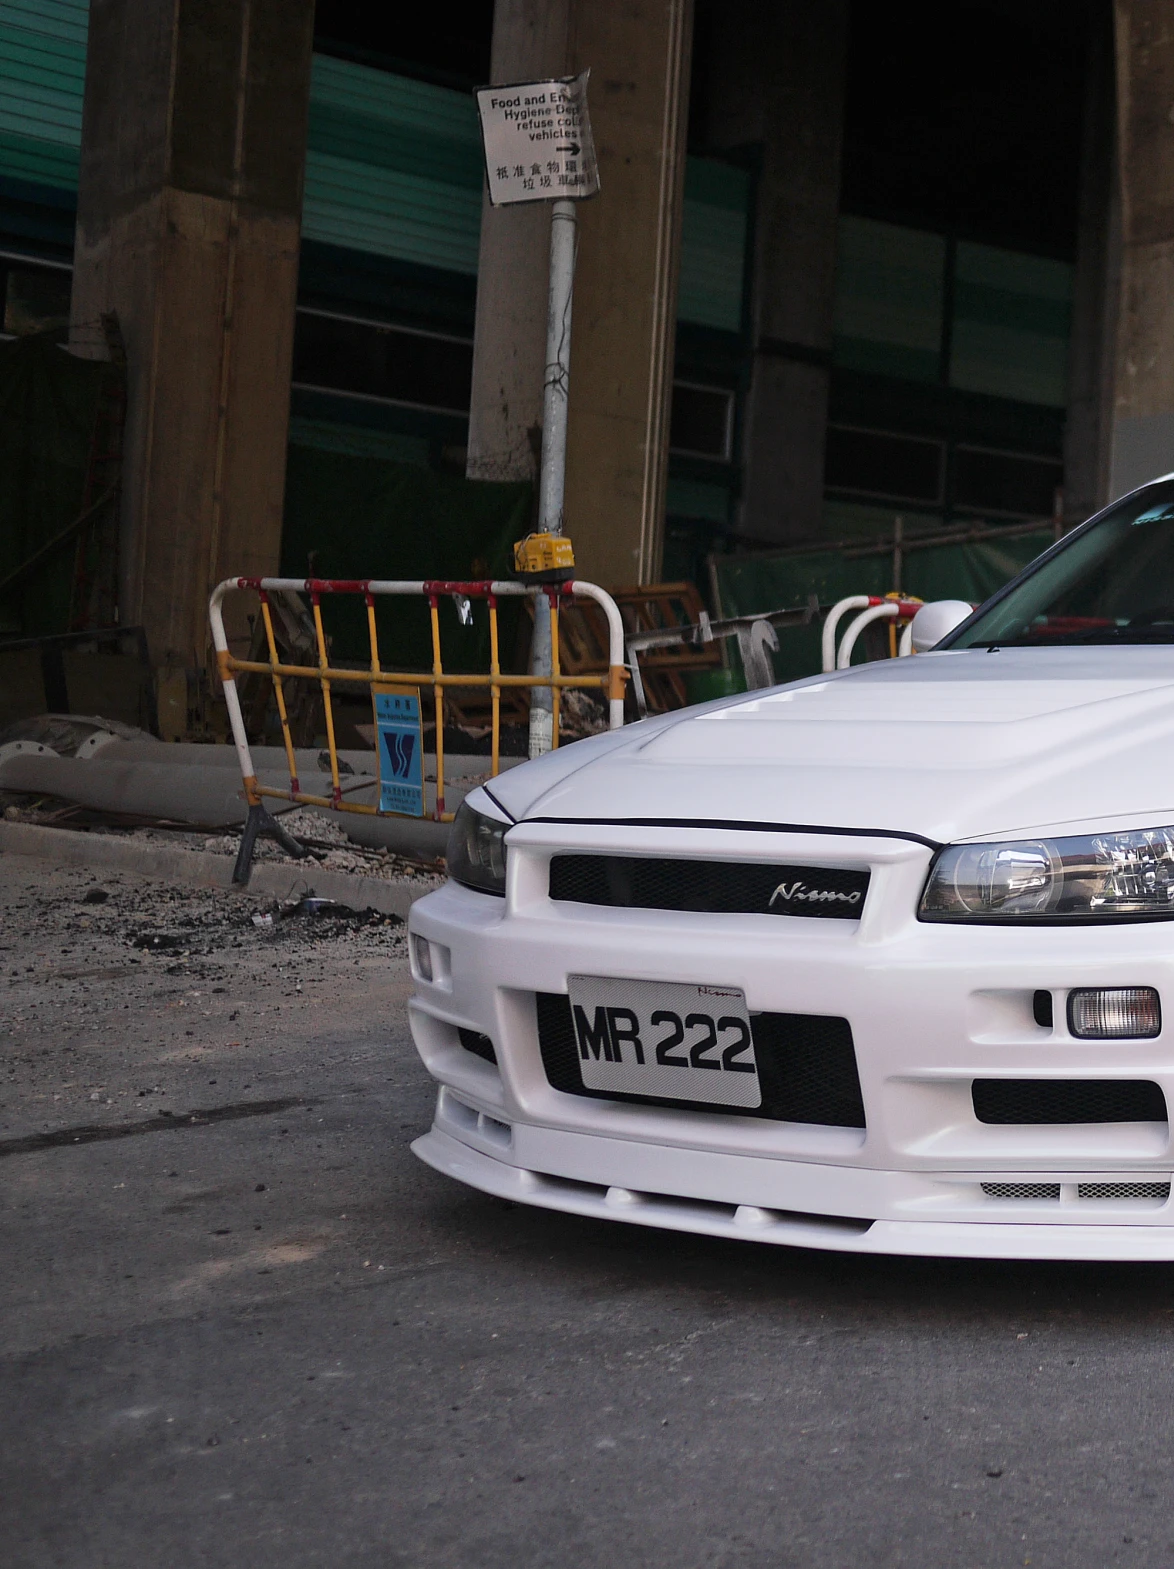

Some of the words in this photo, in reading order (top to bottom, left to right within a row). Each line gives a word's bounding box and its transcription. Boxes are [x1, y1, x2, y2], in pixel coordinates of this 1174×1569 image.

[491, 96, 521, 109] Food
[524, 93, 546, 105] and
[504, 107, 551, 121] Hygiene
[517, 118, 553, 131] refuse
[529, 128, 577, 141] vehicles
[573, 1004, 646, 1065] MR
[650, 1010, 756, 1074] 222
